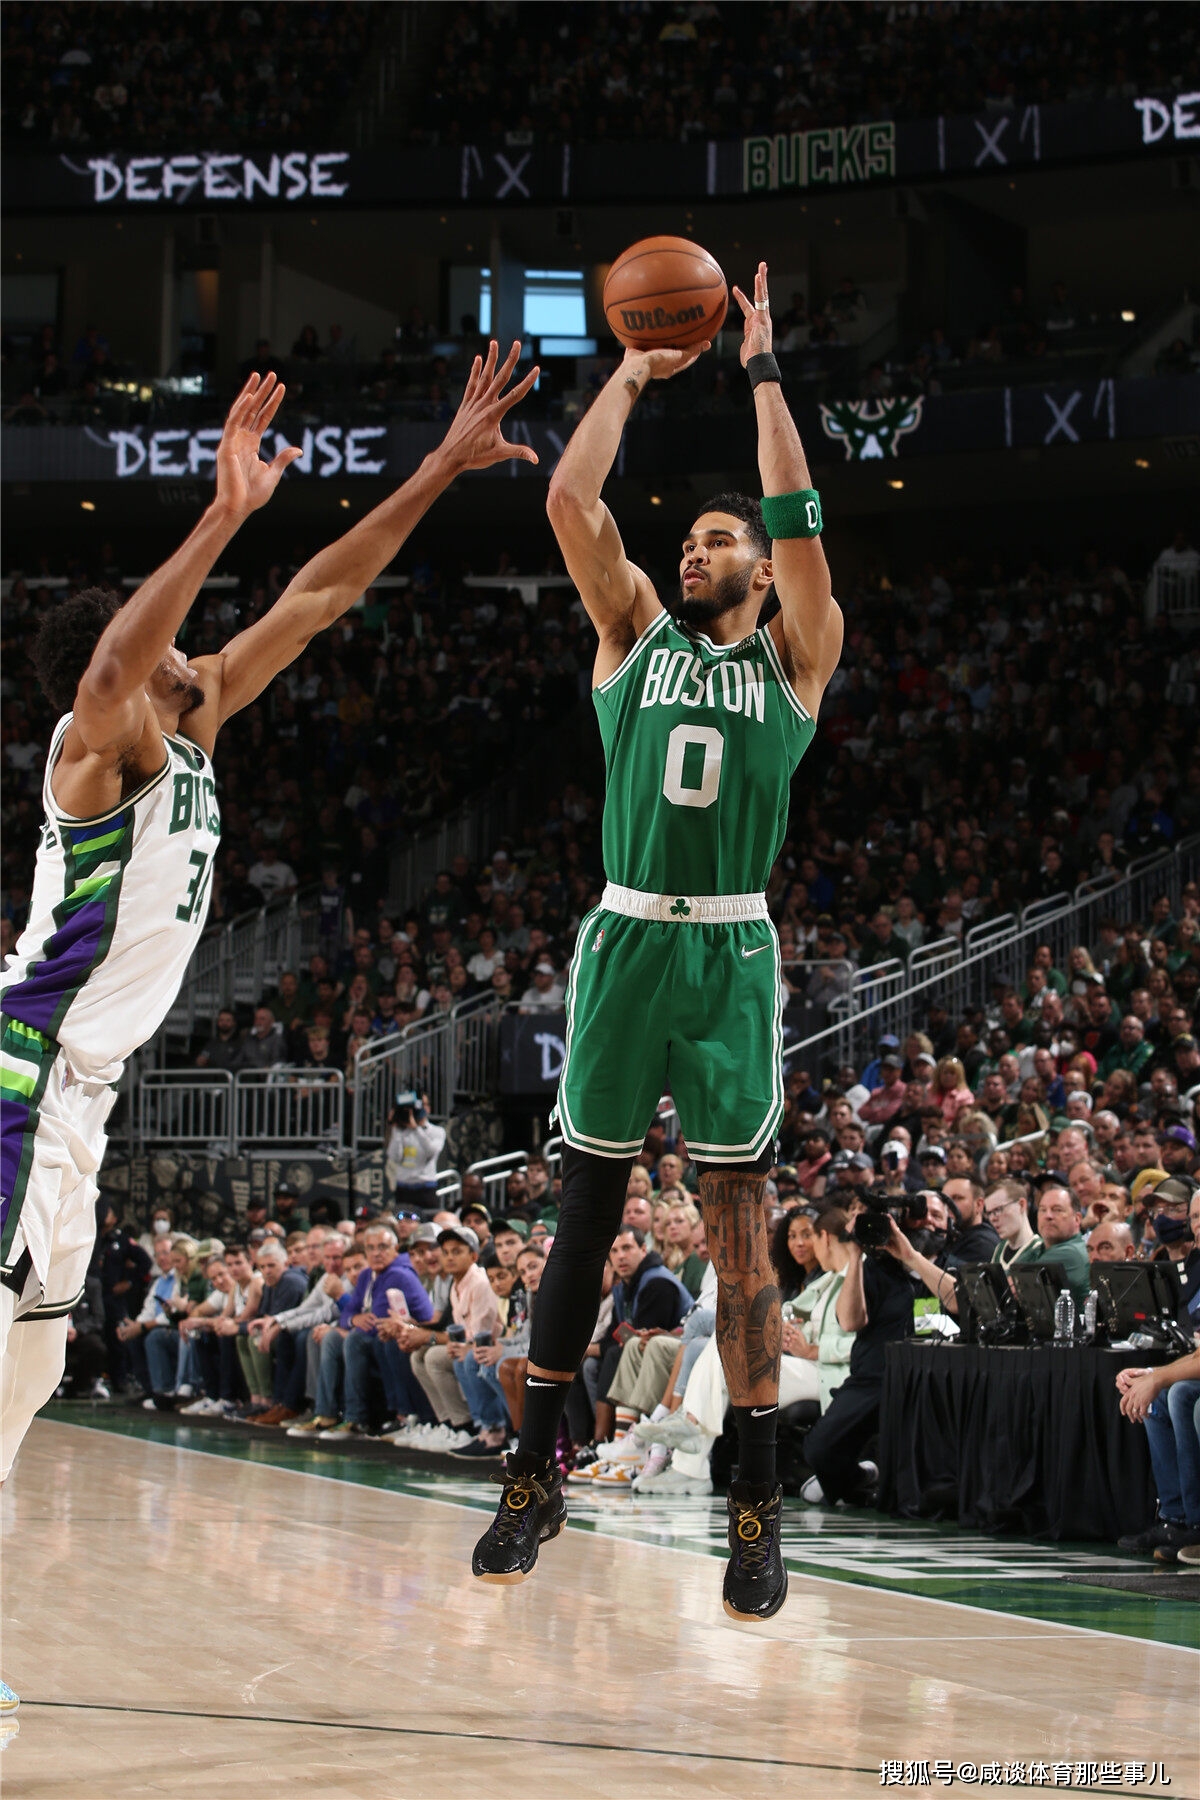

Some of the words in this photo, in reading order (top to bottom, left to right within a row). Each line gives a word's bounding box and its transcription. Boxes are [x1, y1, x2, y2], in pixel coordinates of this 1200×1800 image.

[87, 153, 350, 202] DEFENSE
[743, 121, 895, 193] BUCKS
[621, 304, 706, 331] Wilson
[108, 426, 387, 477] DEFNSE
[805, 500, 818, 529] 0
[640, 648, 765, 724] BOSTON
[663, 723, 724, 808] 0
[169, 773, 220, 836] BUC
